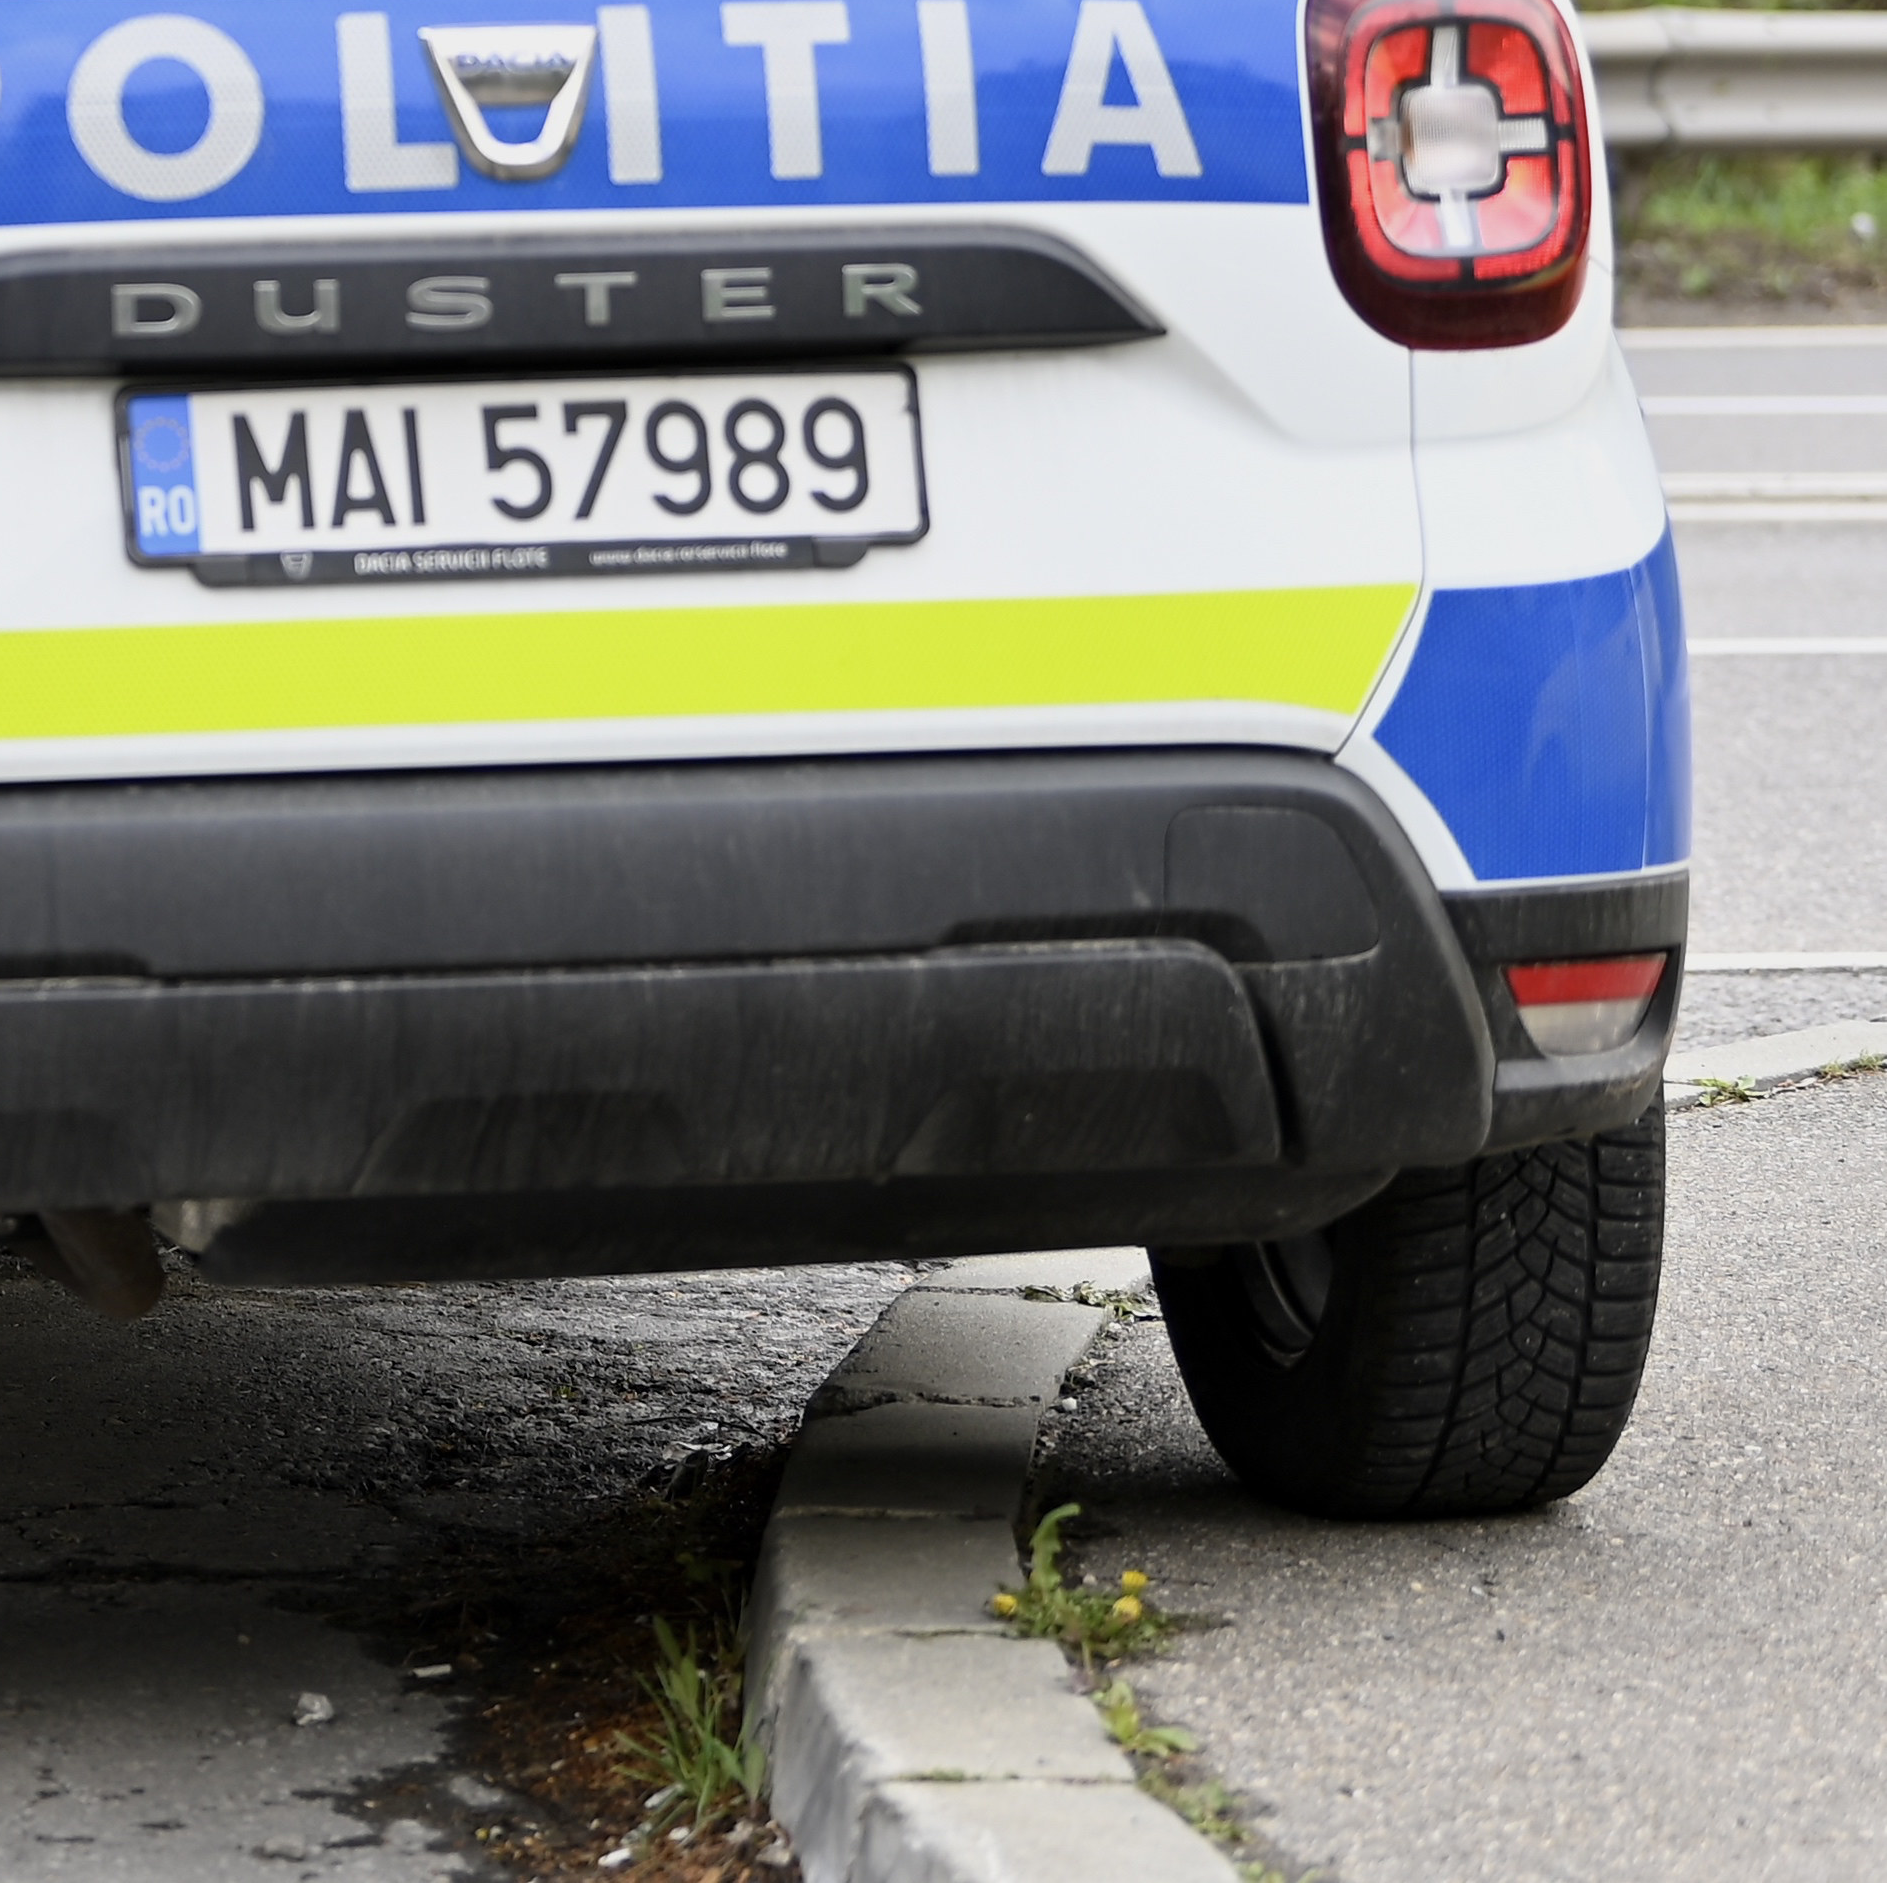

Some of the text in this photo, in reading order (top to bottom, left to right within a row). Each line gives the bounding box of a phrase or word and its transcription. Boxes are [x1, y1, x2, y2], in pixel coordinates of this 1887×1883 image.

[111, 263, 921, 338] DUSTER
[231, 396, 871, 532] MAI 57989
[138, 483, 195, 537] RO
